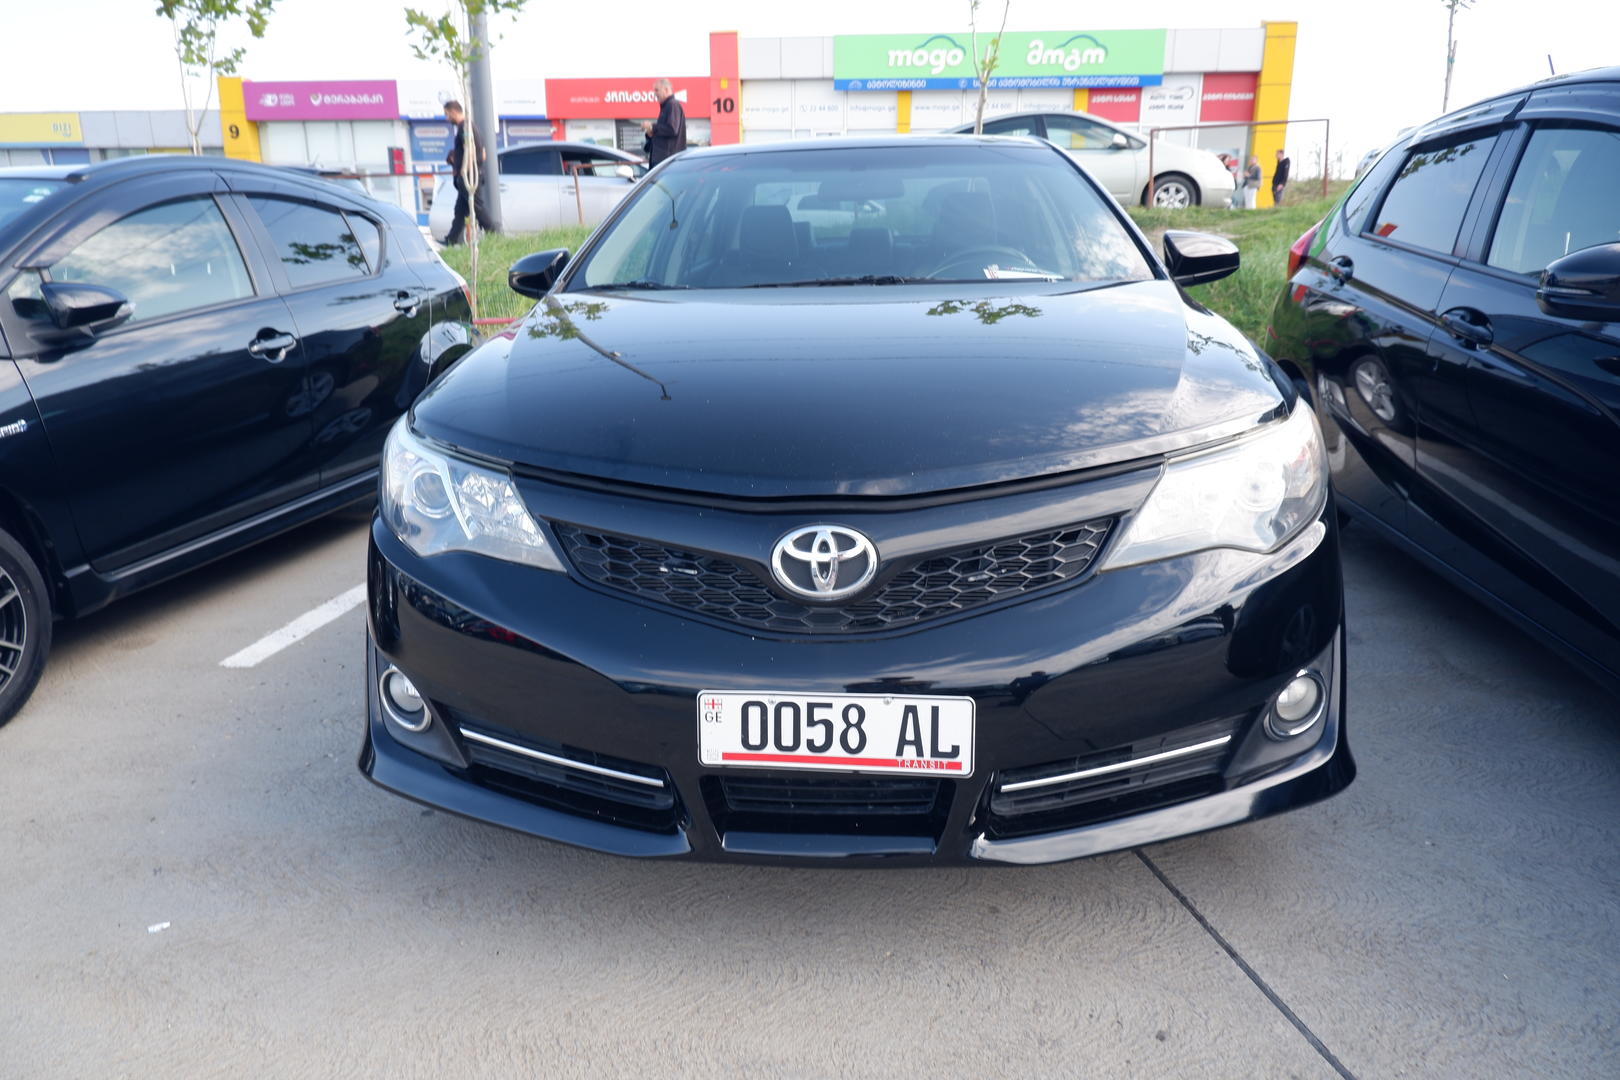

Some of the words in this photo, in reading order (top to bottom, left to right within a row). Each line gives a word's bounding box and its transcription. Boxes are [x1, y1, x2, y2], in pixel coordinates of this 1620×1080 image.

[888, 48, 964, 75] mogo
[1027, 40, 1105, 71] მოგო
[713, 98, 735, 114] 10
[229, 124, 240, 139] 9
[704, 711, 723, 724] GE
[741, 700, 867, 755] 0058
[895, 704, 961, 760] AL
[896, 759, 949, 770] TRANSIT
